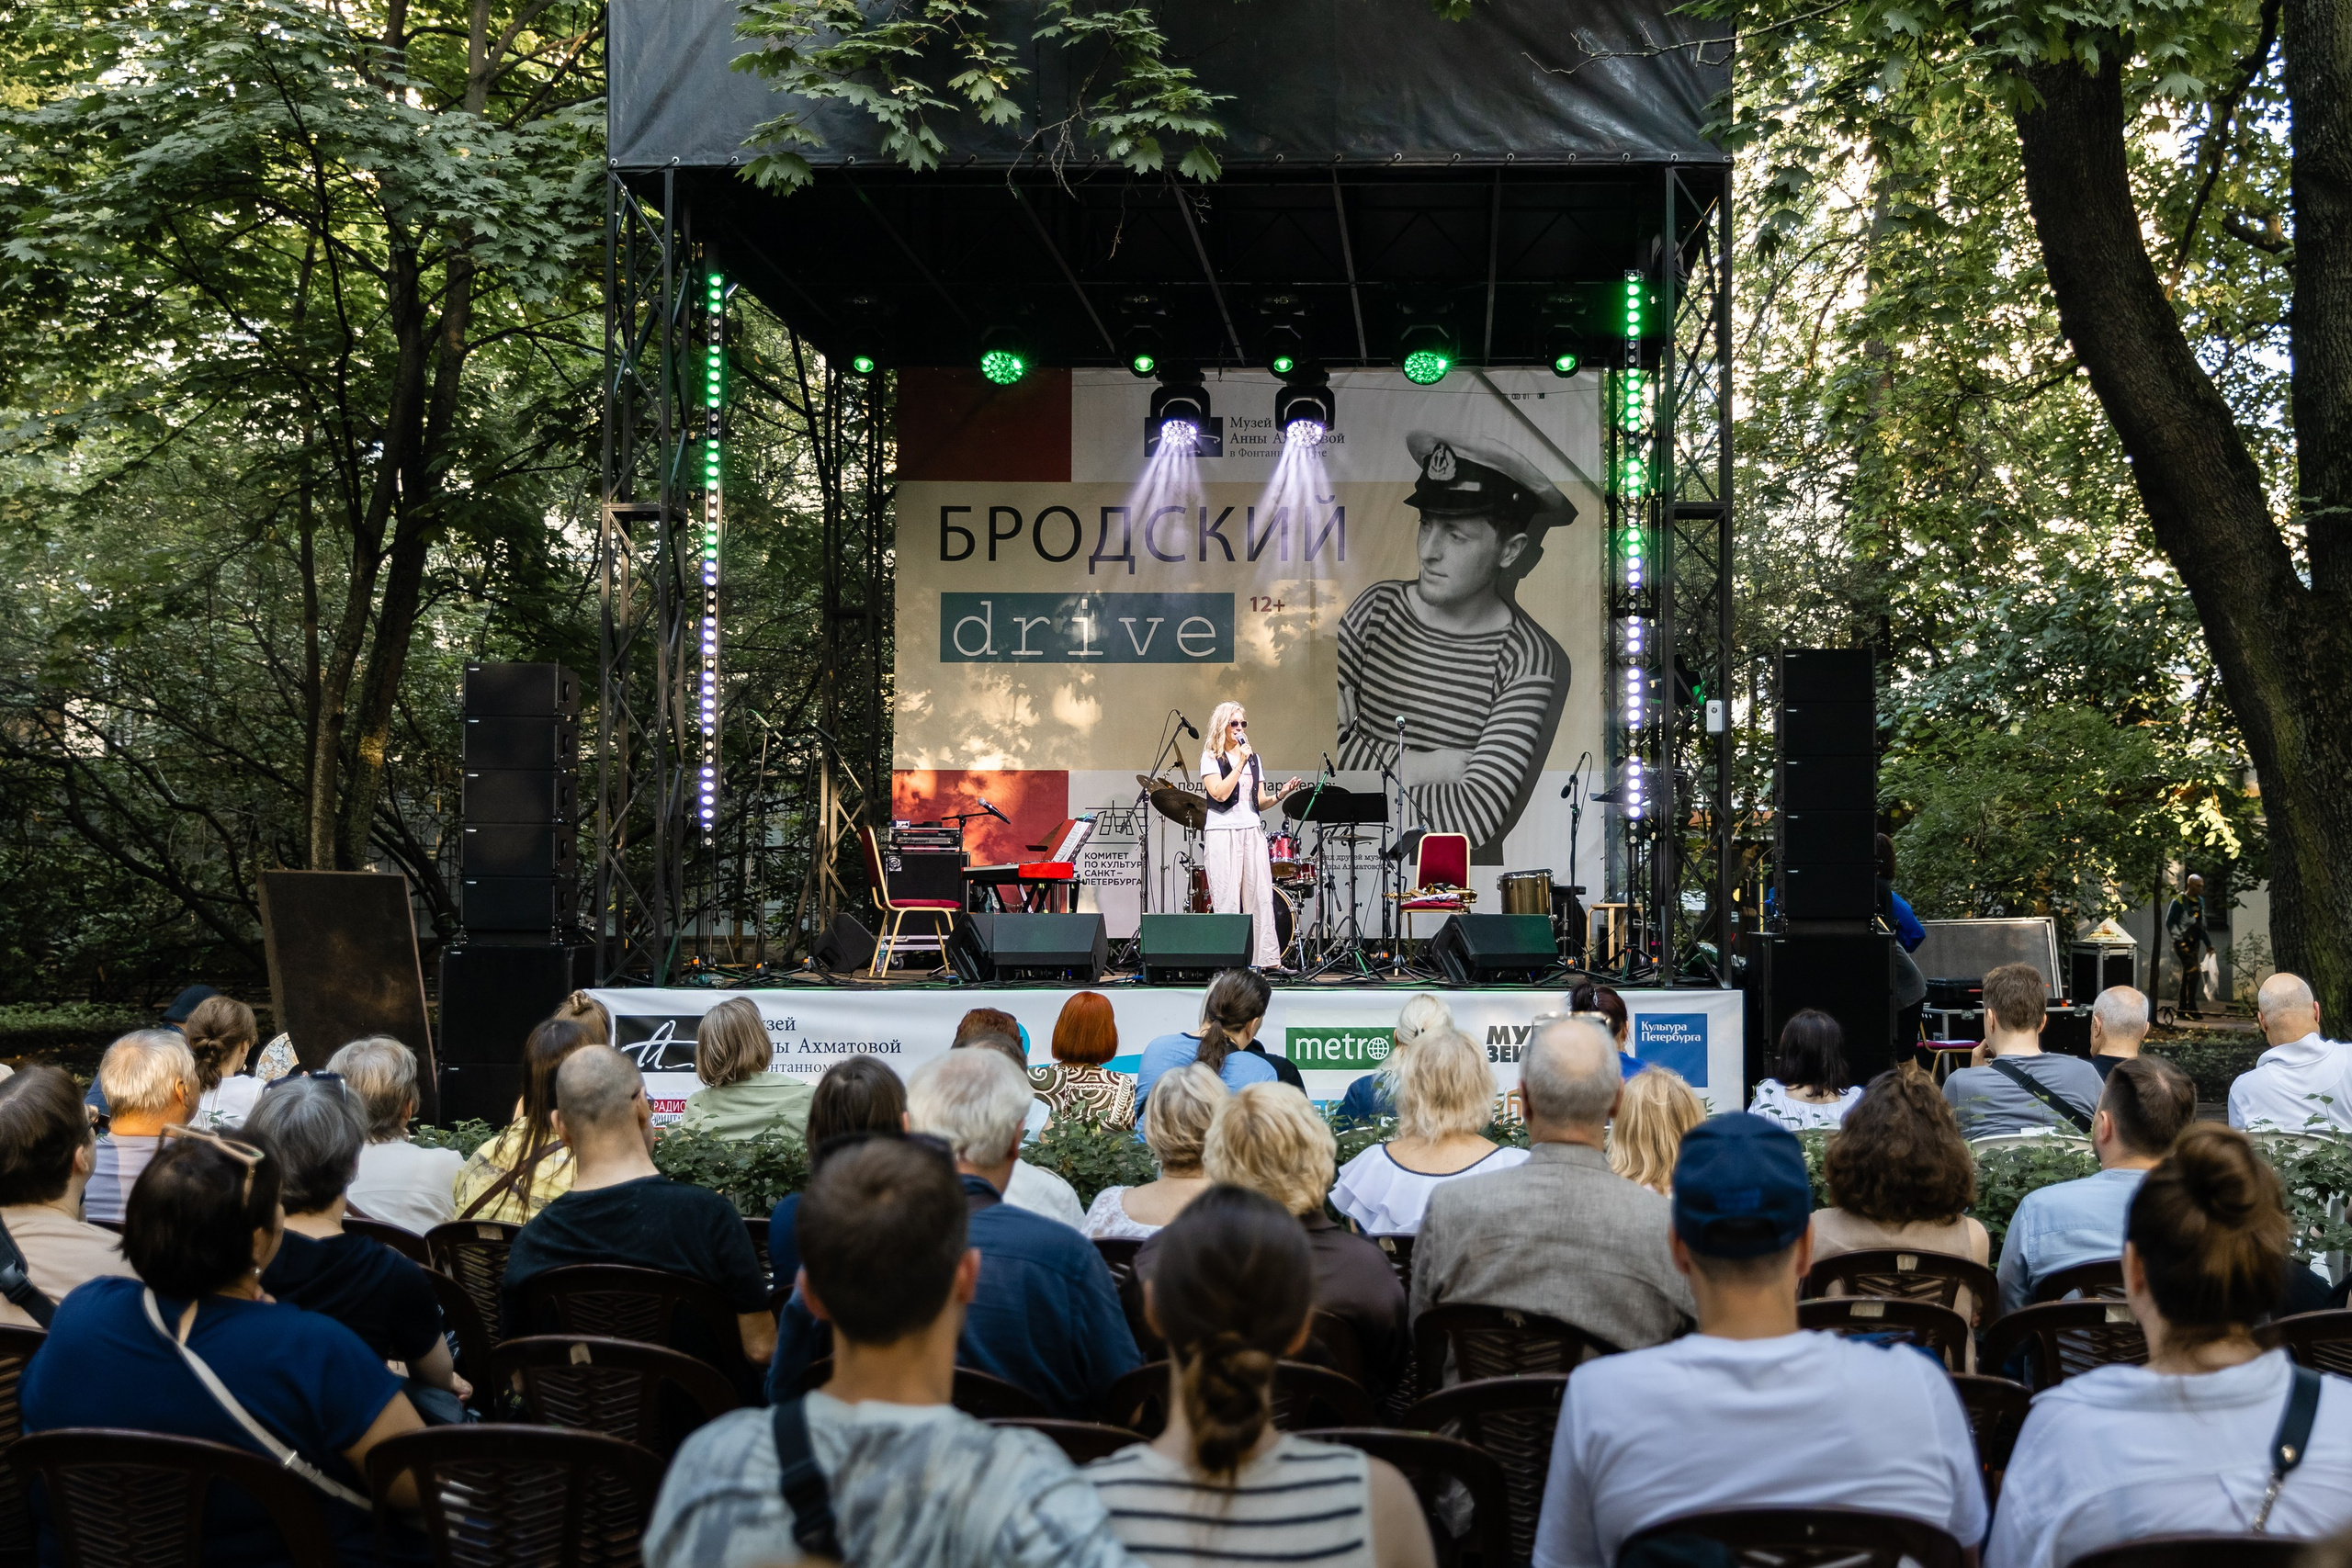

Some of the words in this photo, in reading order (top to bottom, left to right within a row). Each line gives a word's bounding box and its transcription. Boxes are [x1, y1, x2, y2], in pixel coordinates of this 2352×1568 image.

[1229, 416, 1272, 431] Музей
[1229, 433, 1267, 445] Анны
[940, 494, 1345, 575] БРОДСКИЙ
[1250, 595, 1285, 613] 12+
[953, 599, 1216, 658] drive
[763, 1017, 797, 1031] зей
[1641, 1021, 1688, 1034] Культура
[1641, 1031, 1702, 1043] Петербурга
[797, 1038, 902, 1054] Ахматовой
[1295, 1032, 1390, 1060] metro
[653, 1100, 687, 1112] РАДИО
